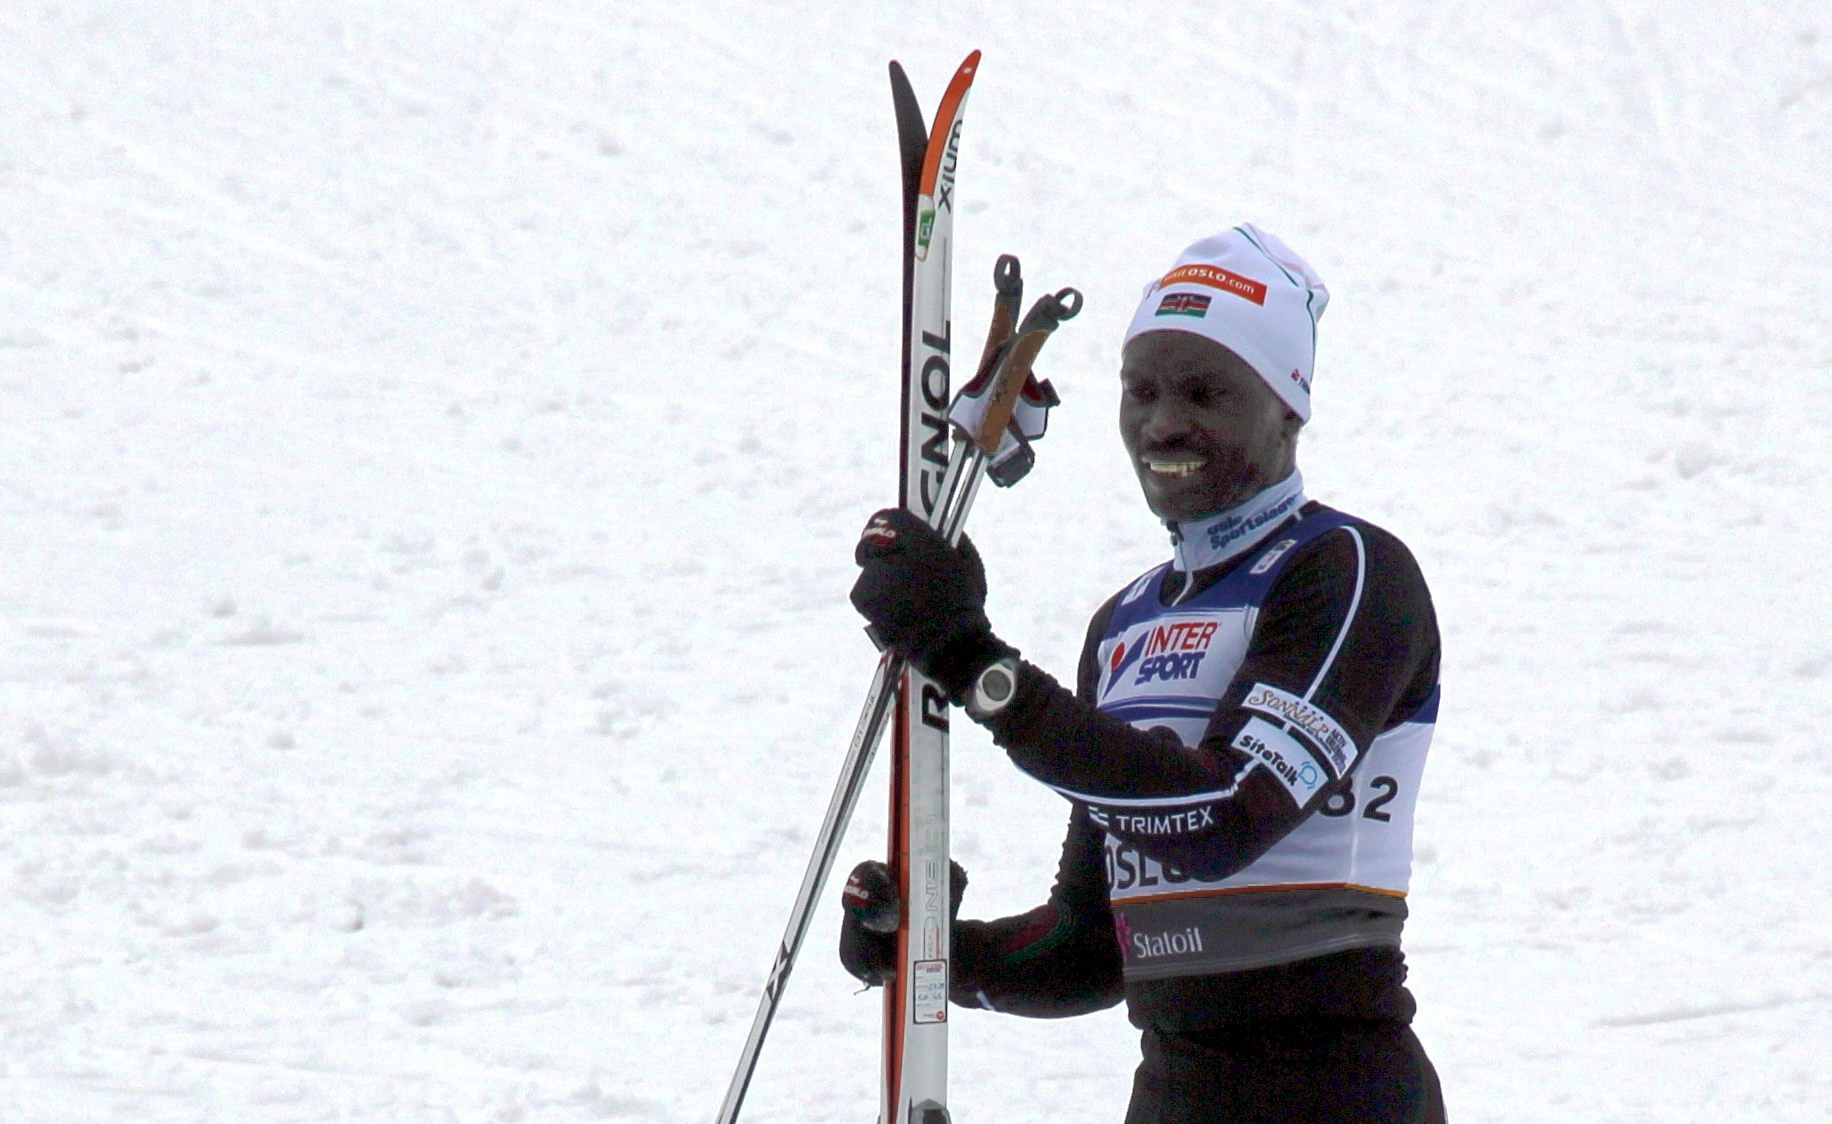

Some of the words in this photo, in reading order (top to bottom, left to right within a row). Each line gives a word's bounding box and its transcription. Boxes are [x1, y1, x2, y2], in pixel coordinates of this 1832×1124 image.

[1144, 621, 1219, 658] INTER
[1133, 651, 1206, 687] SPORT
[1115, 805, 1214, 834] TRIMTEX
[1133, 927, 1203, 959] Statoil
